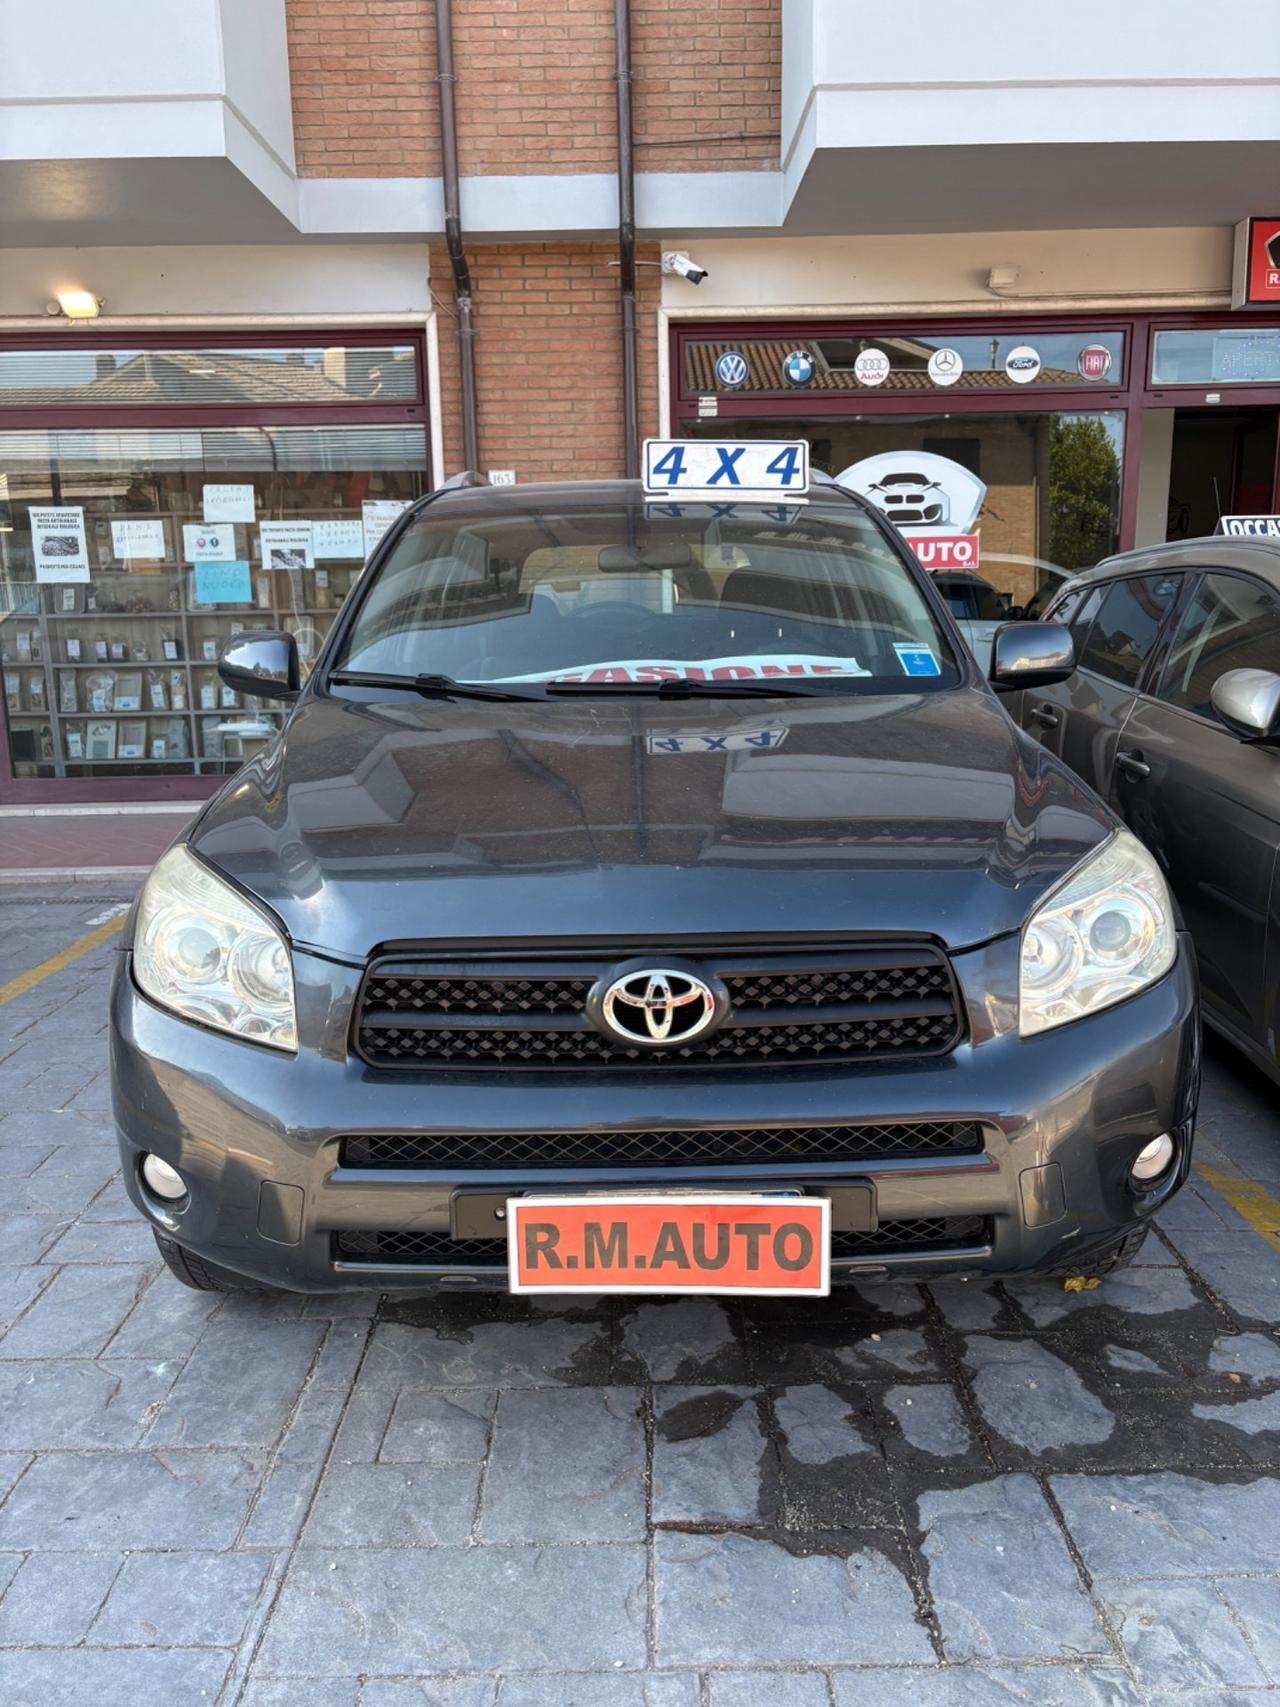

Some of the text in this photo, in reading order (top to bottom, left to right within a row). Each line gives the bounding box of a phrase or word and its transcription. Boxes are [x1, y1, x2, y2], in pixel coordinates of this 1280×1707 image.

[1012, 358, 1034, 369] Ford
[1086, 354, 1105, 372] FIAT
[860, 371, 884, 381] Audi
[652, 446, 800, 485] 4 X 4
[1229, 519, 1280, 536] OCCA
[909, 541, 972, 562] UTO
[524, 1221, 814, 1272] R.M.AUTO
